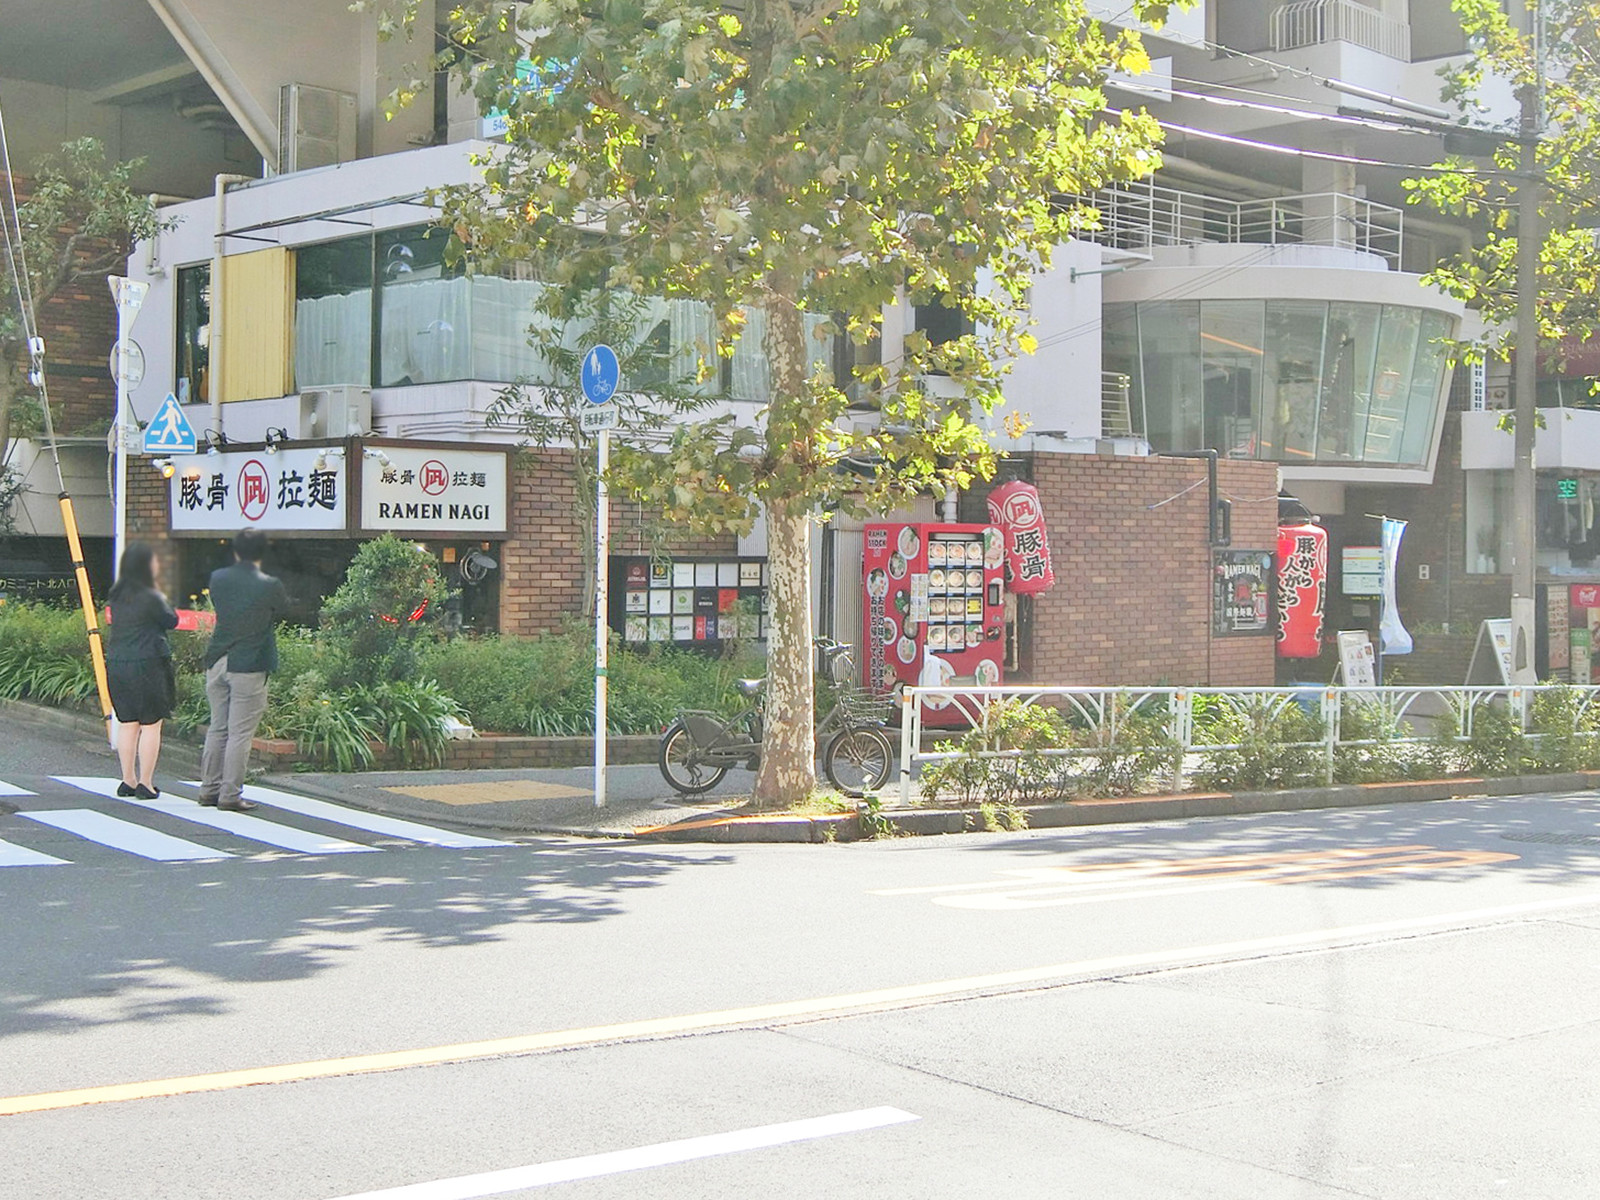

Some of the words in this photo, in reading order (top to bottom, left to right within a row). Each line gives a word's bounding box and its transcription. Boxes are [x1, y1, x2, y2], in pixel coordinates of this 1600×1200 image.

[379, 502, 442, 519] RAMEN
[449, 504, 489, 520] NAGI
[868, 539, 887, 547] STOCK
[1013, 529, 1046, 580] 豚骨
[1295, 537, 1315, 587] 豚がら
